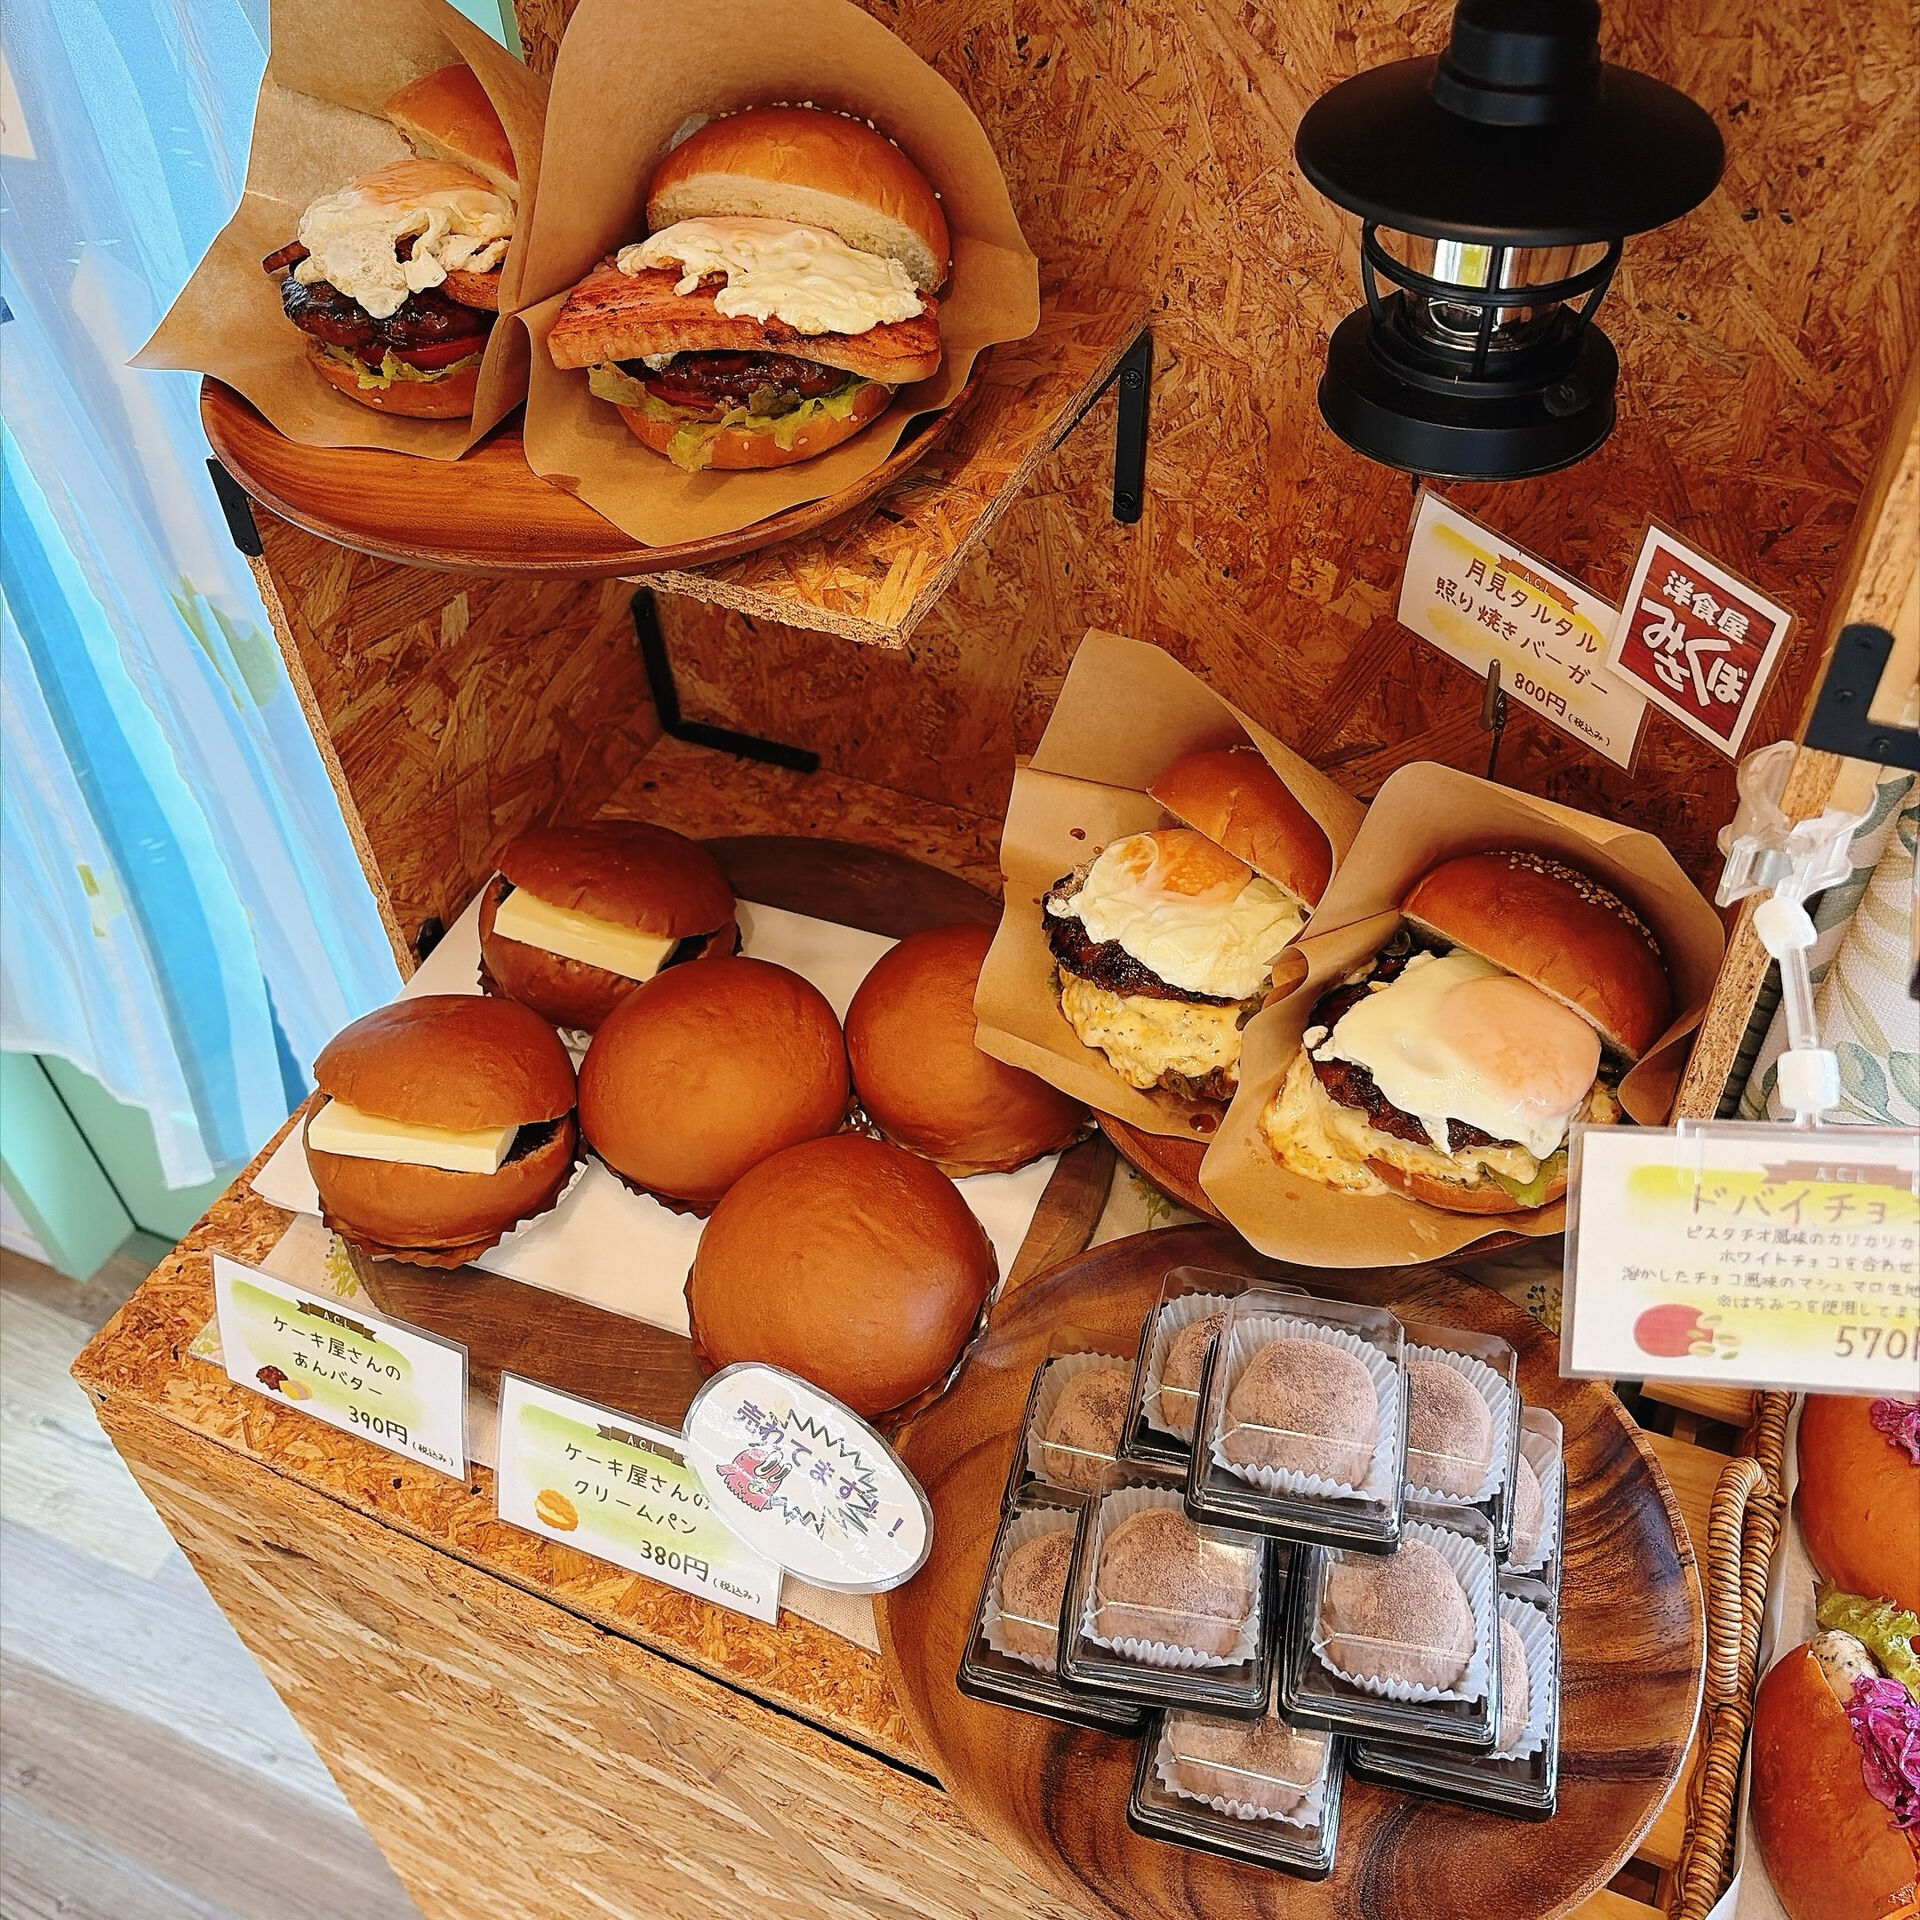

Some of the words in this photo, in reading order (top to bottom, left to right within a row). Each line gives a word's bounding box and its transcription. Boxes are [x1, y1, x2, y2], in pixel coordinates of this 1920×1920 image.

[1465, 558, 1598, 654] 月見タルタル
[1662, 569, 1750, 645] 洋食屋
[1435, 576, 1608, 695] 照り焼きバーガー
[1514, 672, 1567, 717] 800円
[272, 1315, 402, 1382] ケーキ屋さんの
[1834, 1325, 1920, 1363] 570
[293, 1351, 383, 1396] あんバター
[348, 1405, 408, 1446] 390円
[565, 1443, 711, 1511] ケーキ屋さんの
[574, 1480, 697, 1534] クリームパン
[639, 1539, 710, 1583] 380円
